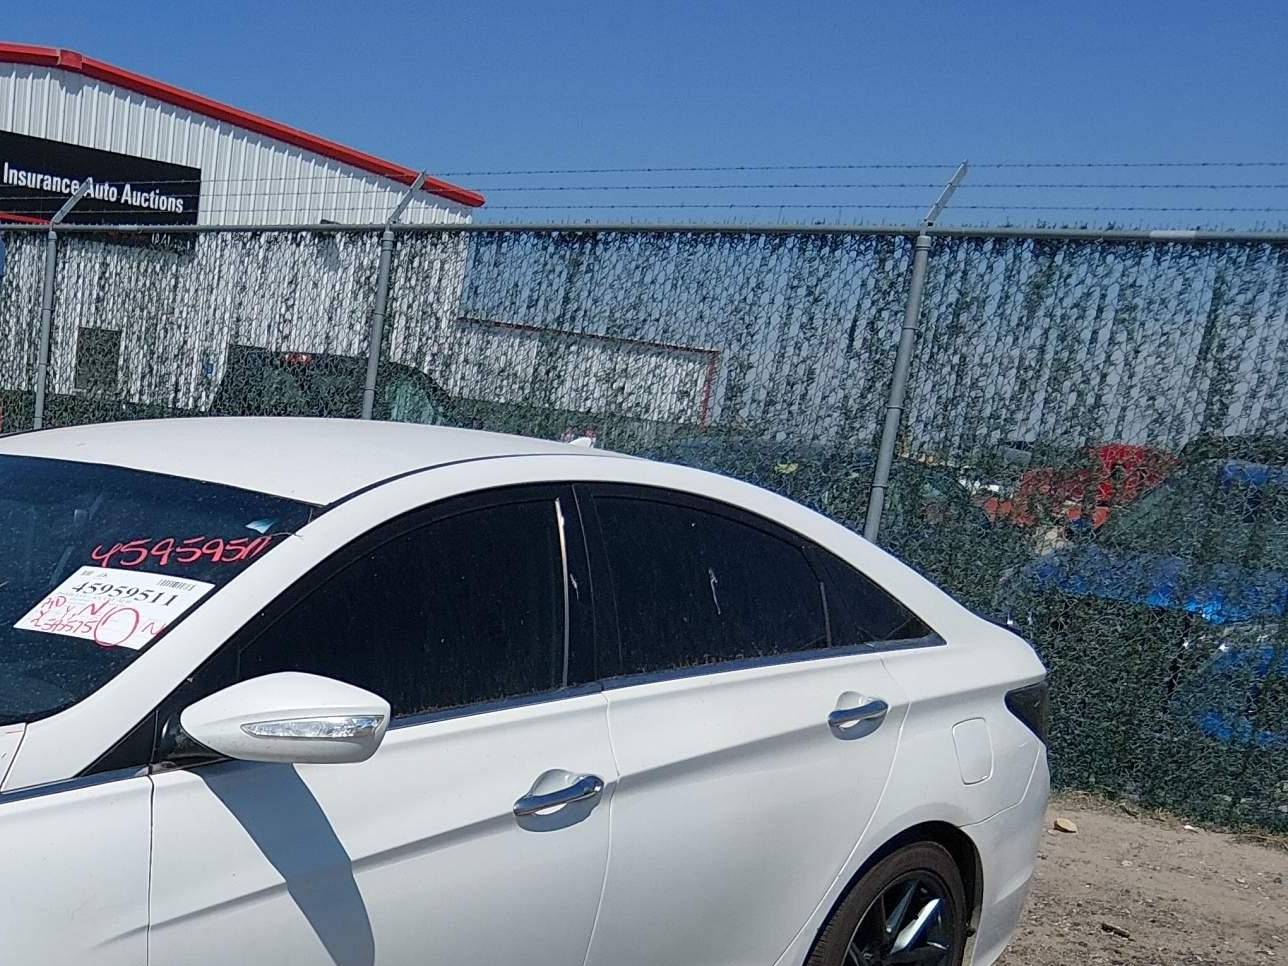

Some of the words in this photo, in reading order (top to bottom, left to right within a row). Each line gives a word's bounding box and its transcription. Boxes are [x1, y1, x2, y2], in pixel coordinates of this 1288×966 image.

[3, 161, 79, 197] Insurance
[83, 176, 118, 202] Auto
[121, 183, 184, 213] Auctions
[72, 581, 178, 607] 45959511
